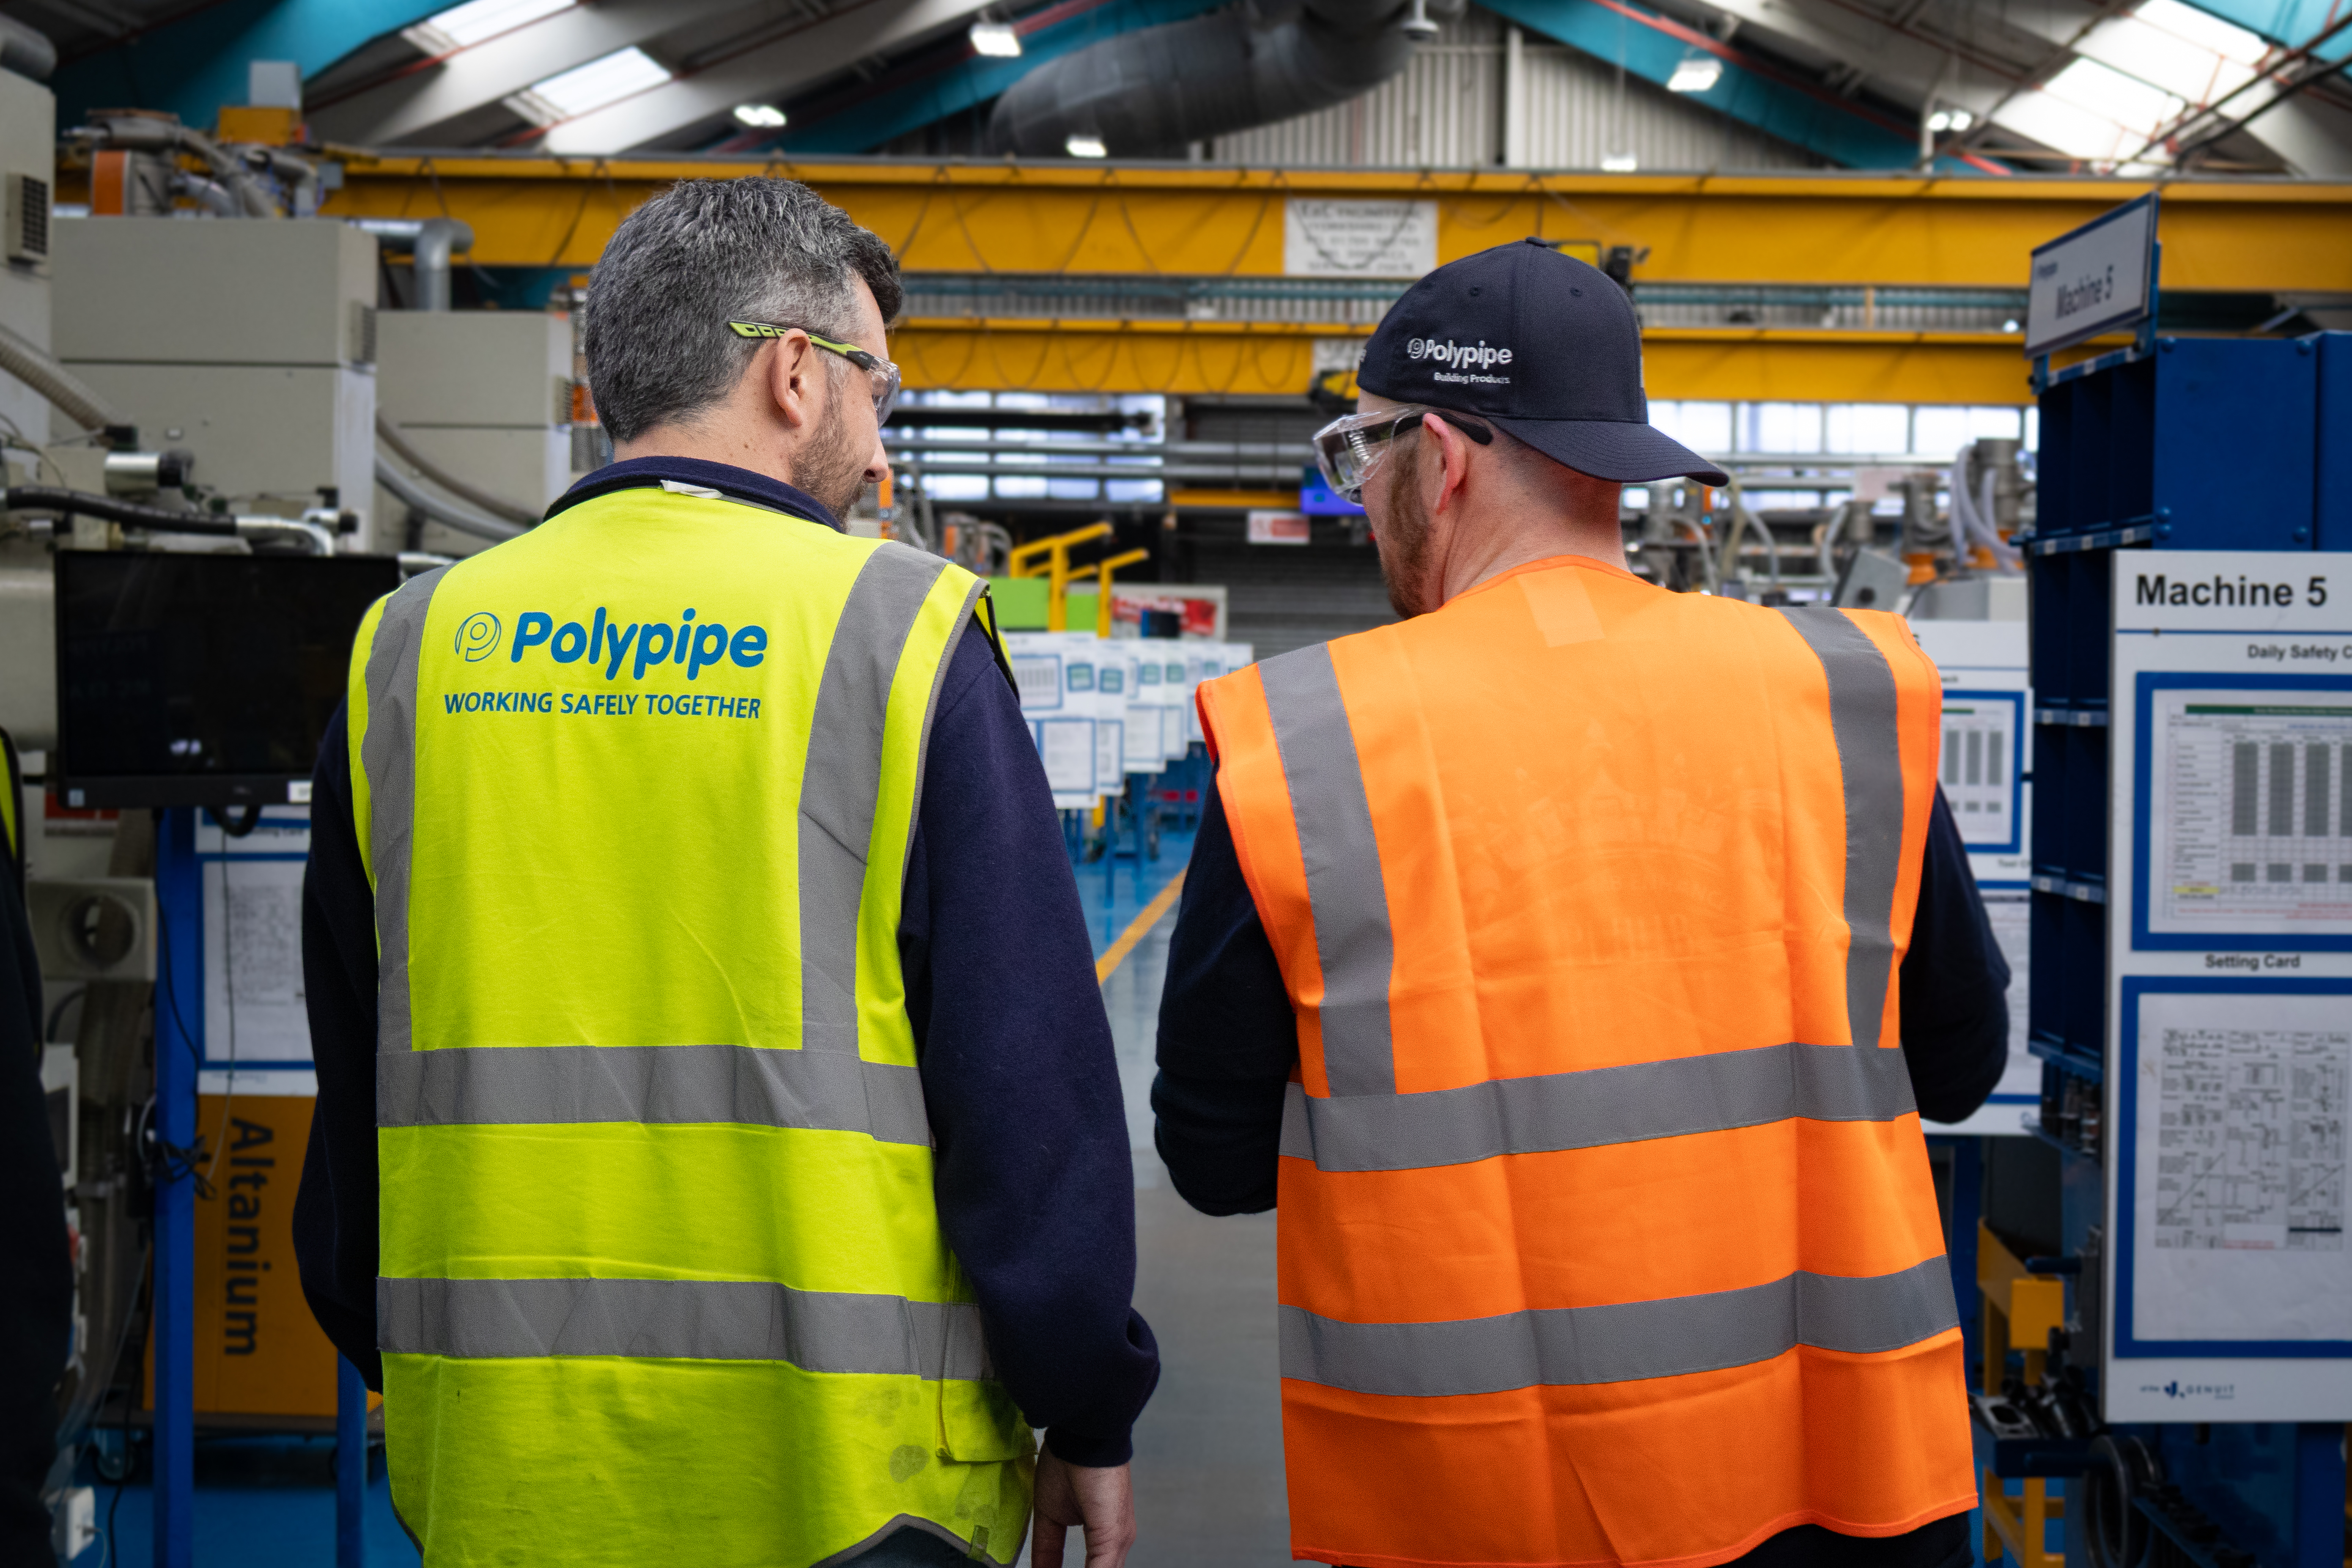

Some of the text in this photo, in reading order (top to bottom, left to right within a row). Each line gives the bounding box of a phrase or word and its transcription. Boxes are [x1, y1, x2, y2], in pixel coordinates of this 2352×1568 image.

[2055, 274, 2102, 321] Machine
[2105, 264, 2113, 301] 5
[1423, 339, 1513, 369] Polypipe
[1433, 372, 1511, 384] Building Products
[2136, 574, 2327, 607] Machine 5
[510, 607, 768, 681] Polypipe
[2248, 645, 2286, 662] Daily
[2290, 645, 2338, 662] Safety
[445, 692, 761, 719] WORKING SAFELY TOGETHER
[2205, 954, 2301, 971] Setting Card
[224, 1117, 275, 1357] Altanium
[2185, 1384, 2234, 1395] GENUIT
